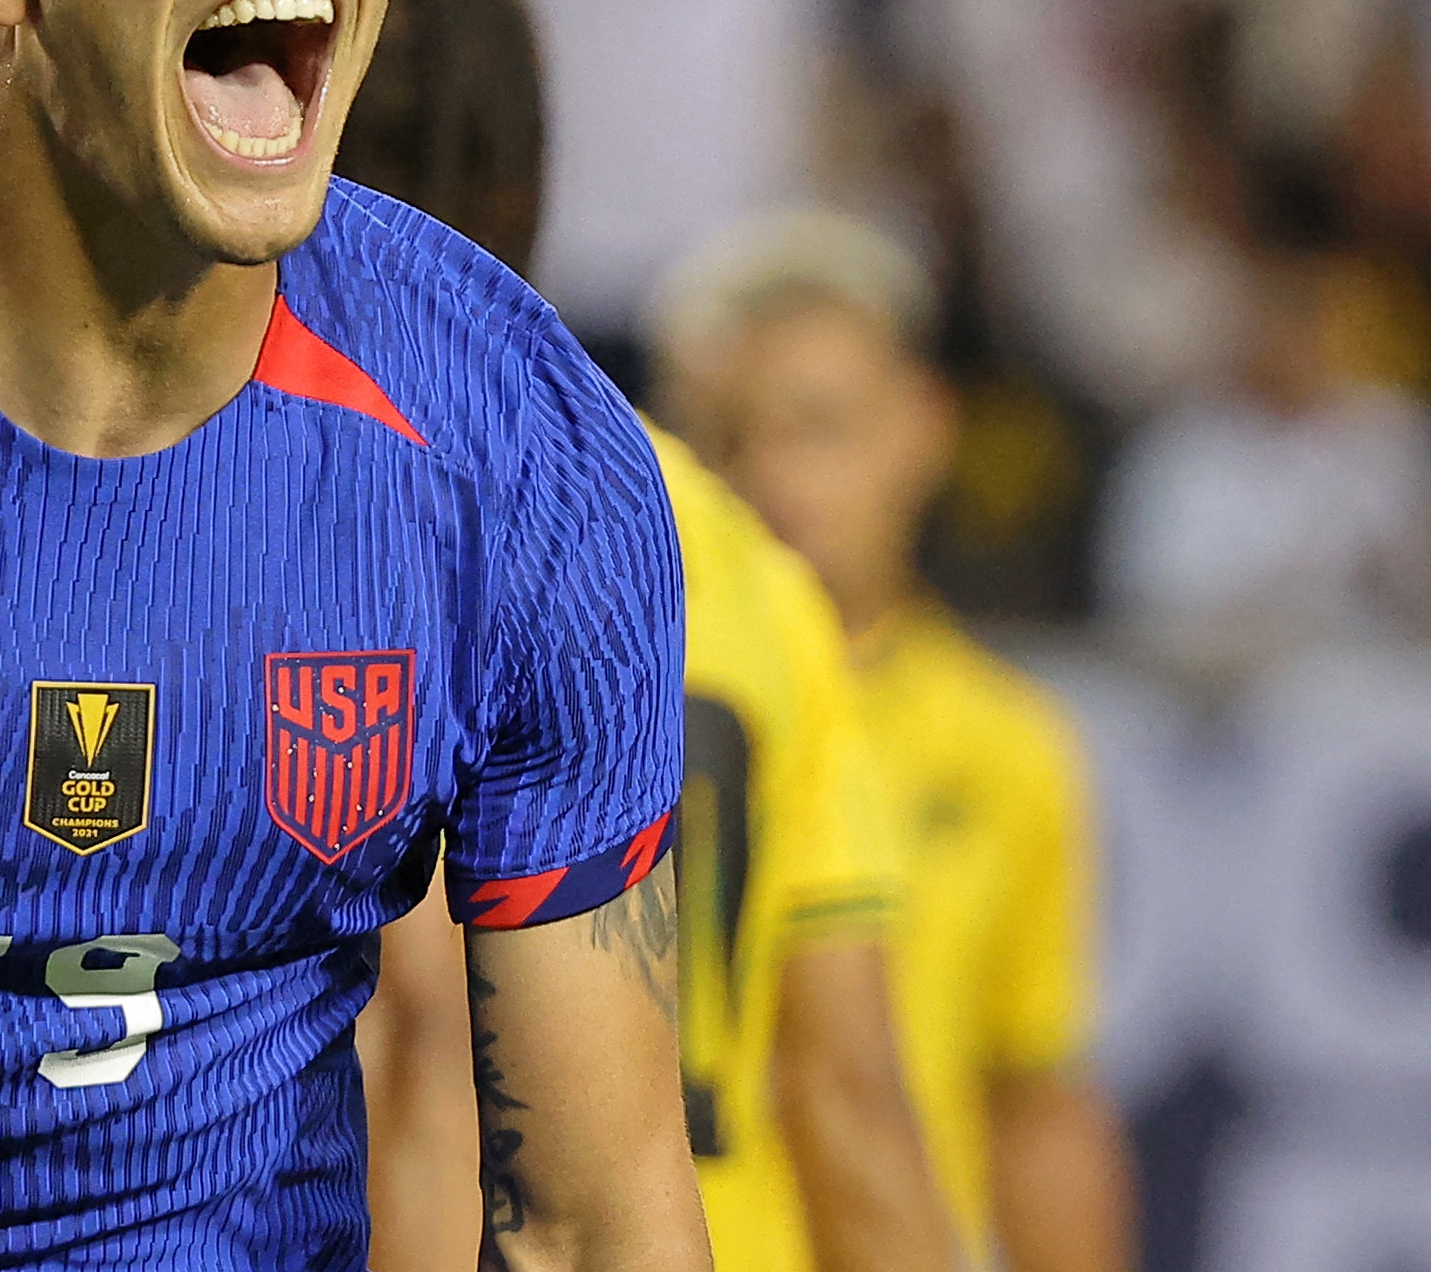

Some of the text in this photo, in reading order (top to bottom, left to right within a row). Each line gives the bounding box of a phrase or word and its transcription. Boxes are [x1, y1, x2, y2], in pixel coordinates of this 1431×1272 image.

[277, 663, 402, 743] USA
[61, 780, 115, 796] GOLD
[67, 797, 107, 813] CUP
[51, 817, 120, 828] CHAMPIONS
[72, 828, 98, 838] 2021
